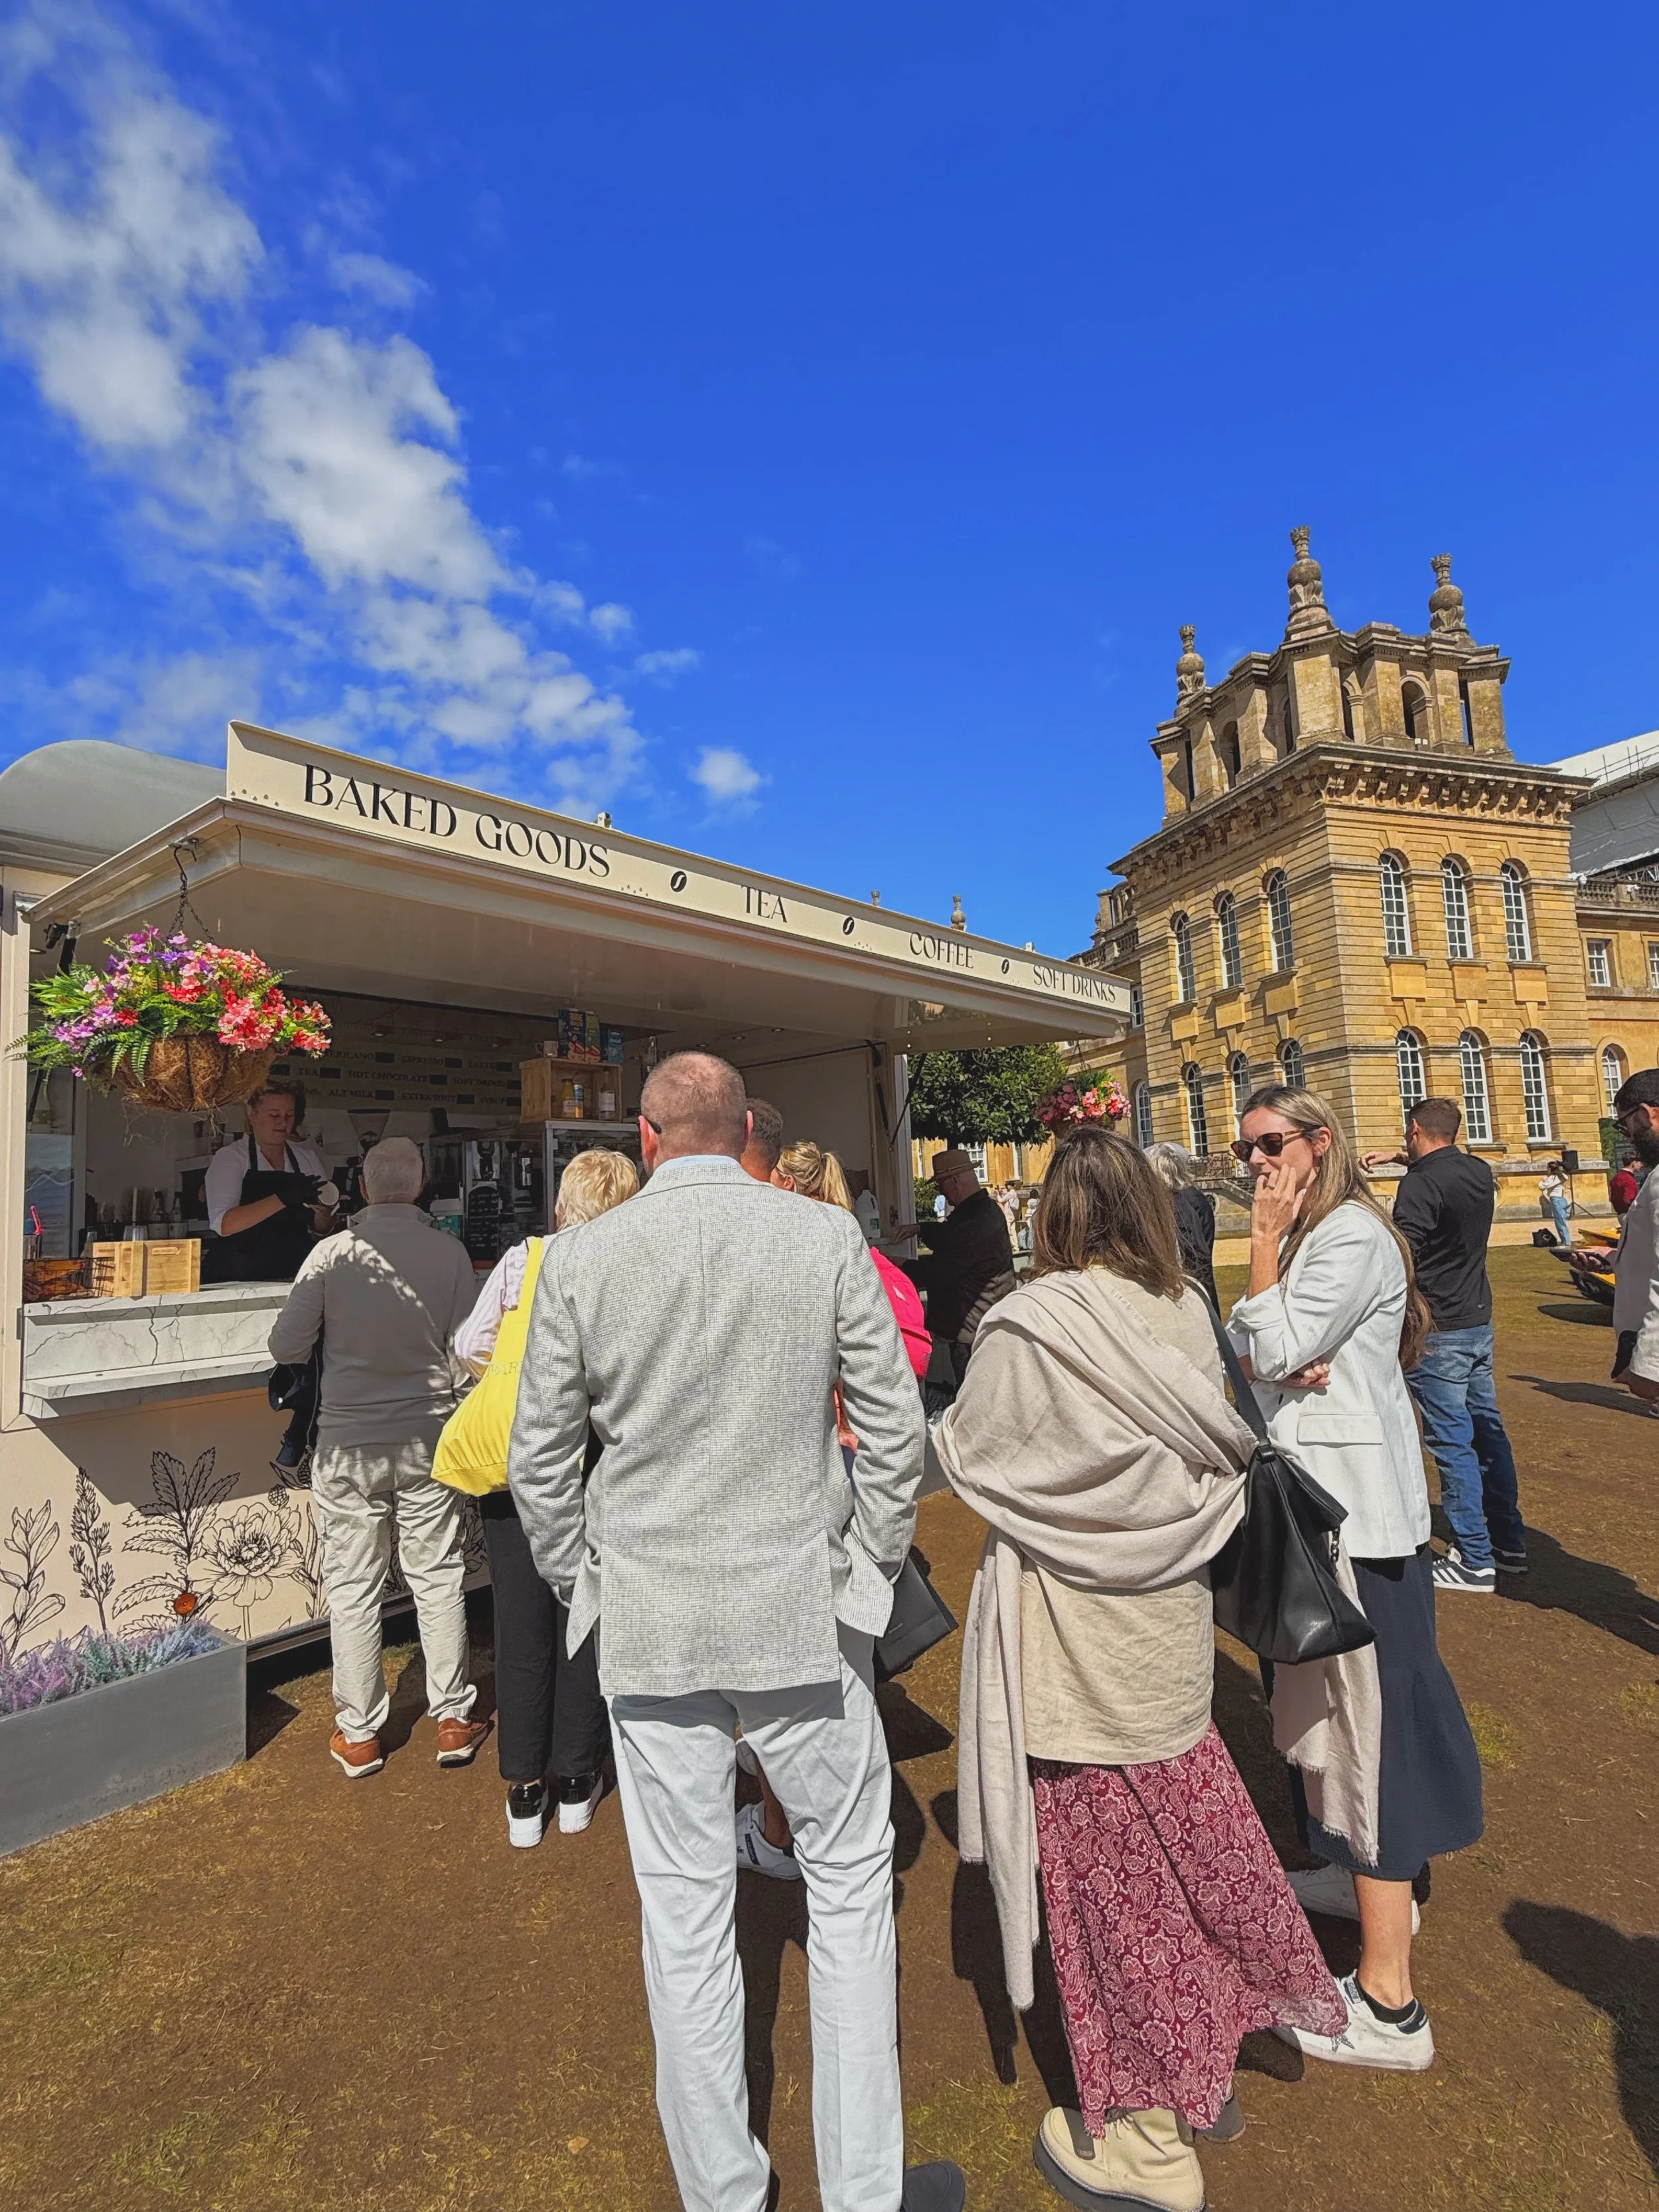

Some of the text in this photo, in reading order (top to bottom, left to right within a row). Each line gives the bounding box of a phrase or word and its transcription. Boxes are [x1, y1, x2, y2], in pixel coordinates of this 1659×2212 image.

[305, 763, 610, 877] BAKED GOODS
[741, 885, 788, 923] TEA
[910, 931, 974, 969] COFFEE
[1033, 964, 1116, 1003] SOFT DRINKS
[326, 1051, 374, 1061] ERICANO
[401, 1055, 444, 1066] ESPRESSO
[468, 1061, 496, 1069] LATTE
[297, 1067, 319, 1076] TEA
[348, 1070, 429, 1083] HOT CHOCOLATE
[453, 1077, 506, 1087] SOFT DRINKS
[328, 1088, 374, 1098] ALT MILK
[401, 1092, 457, 1103] EXTRA SHOT
